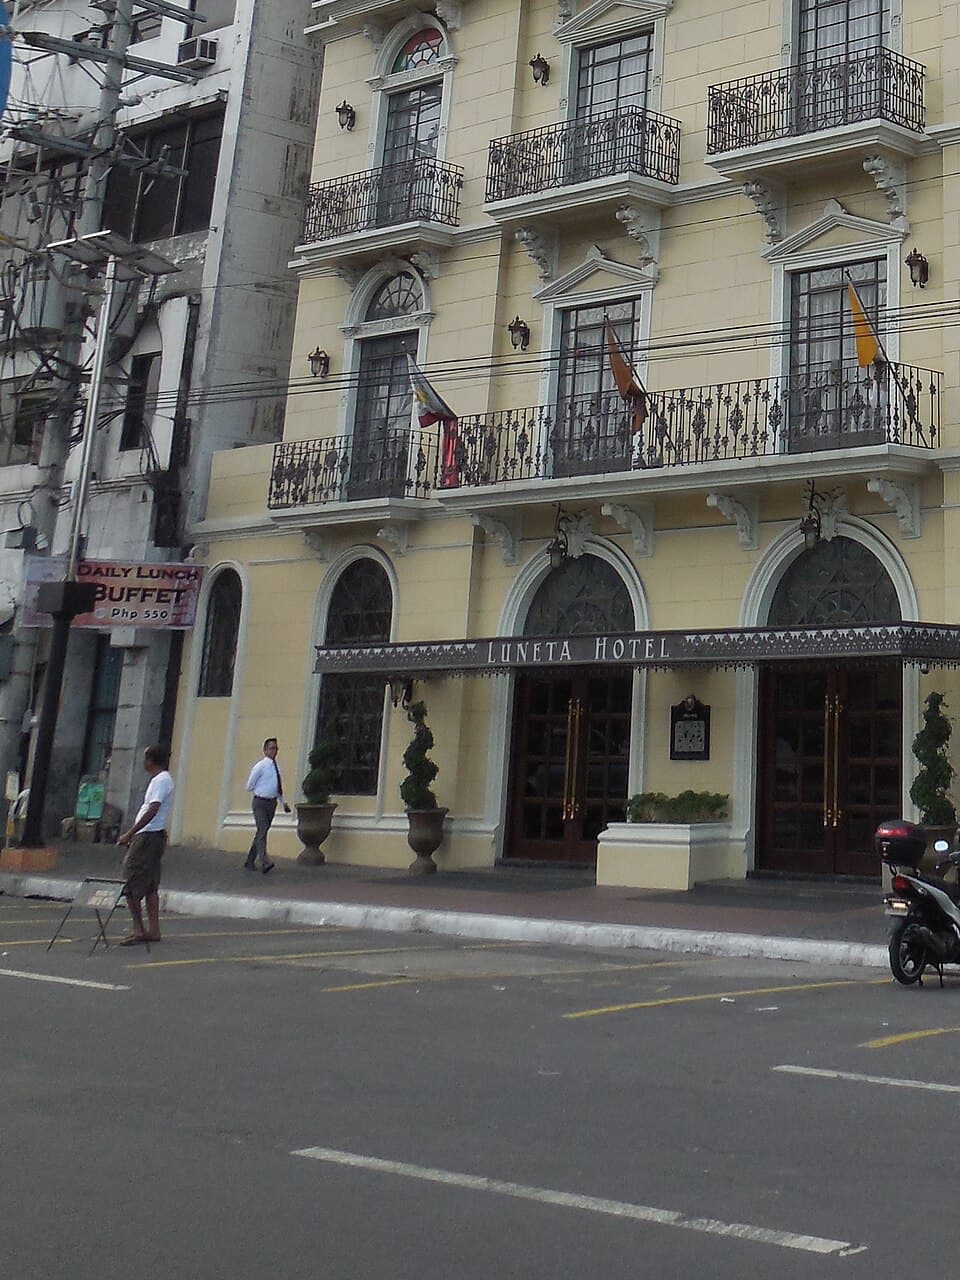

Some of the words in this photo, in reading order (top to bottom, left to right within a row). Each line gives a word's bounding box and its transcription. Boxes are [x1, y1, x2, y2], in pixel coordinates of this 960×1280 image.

[77, 565, 132, 579] DAILY
[136, 566, 199, 581] LUNCH
[94, 583, 188, 604] BUFFET
[111, 608, 138, 620] Php
[144, 609, 168, 619] 550
[487, 640, 572, 663] LUNETA
[594, 636, 671, 660] HOTEL
